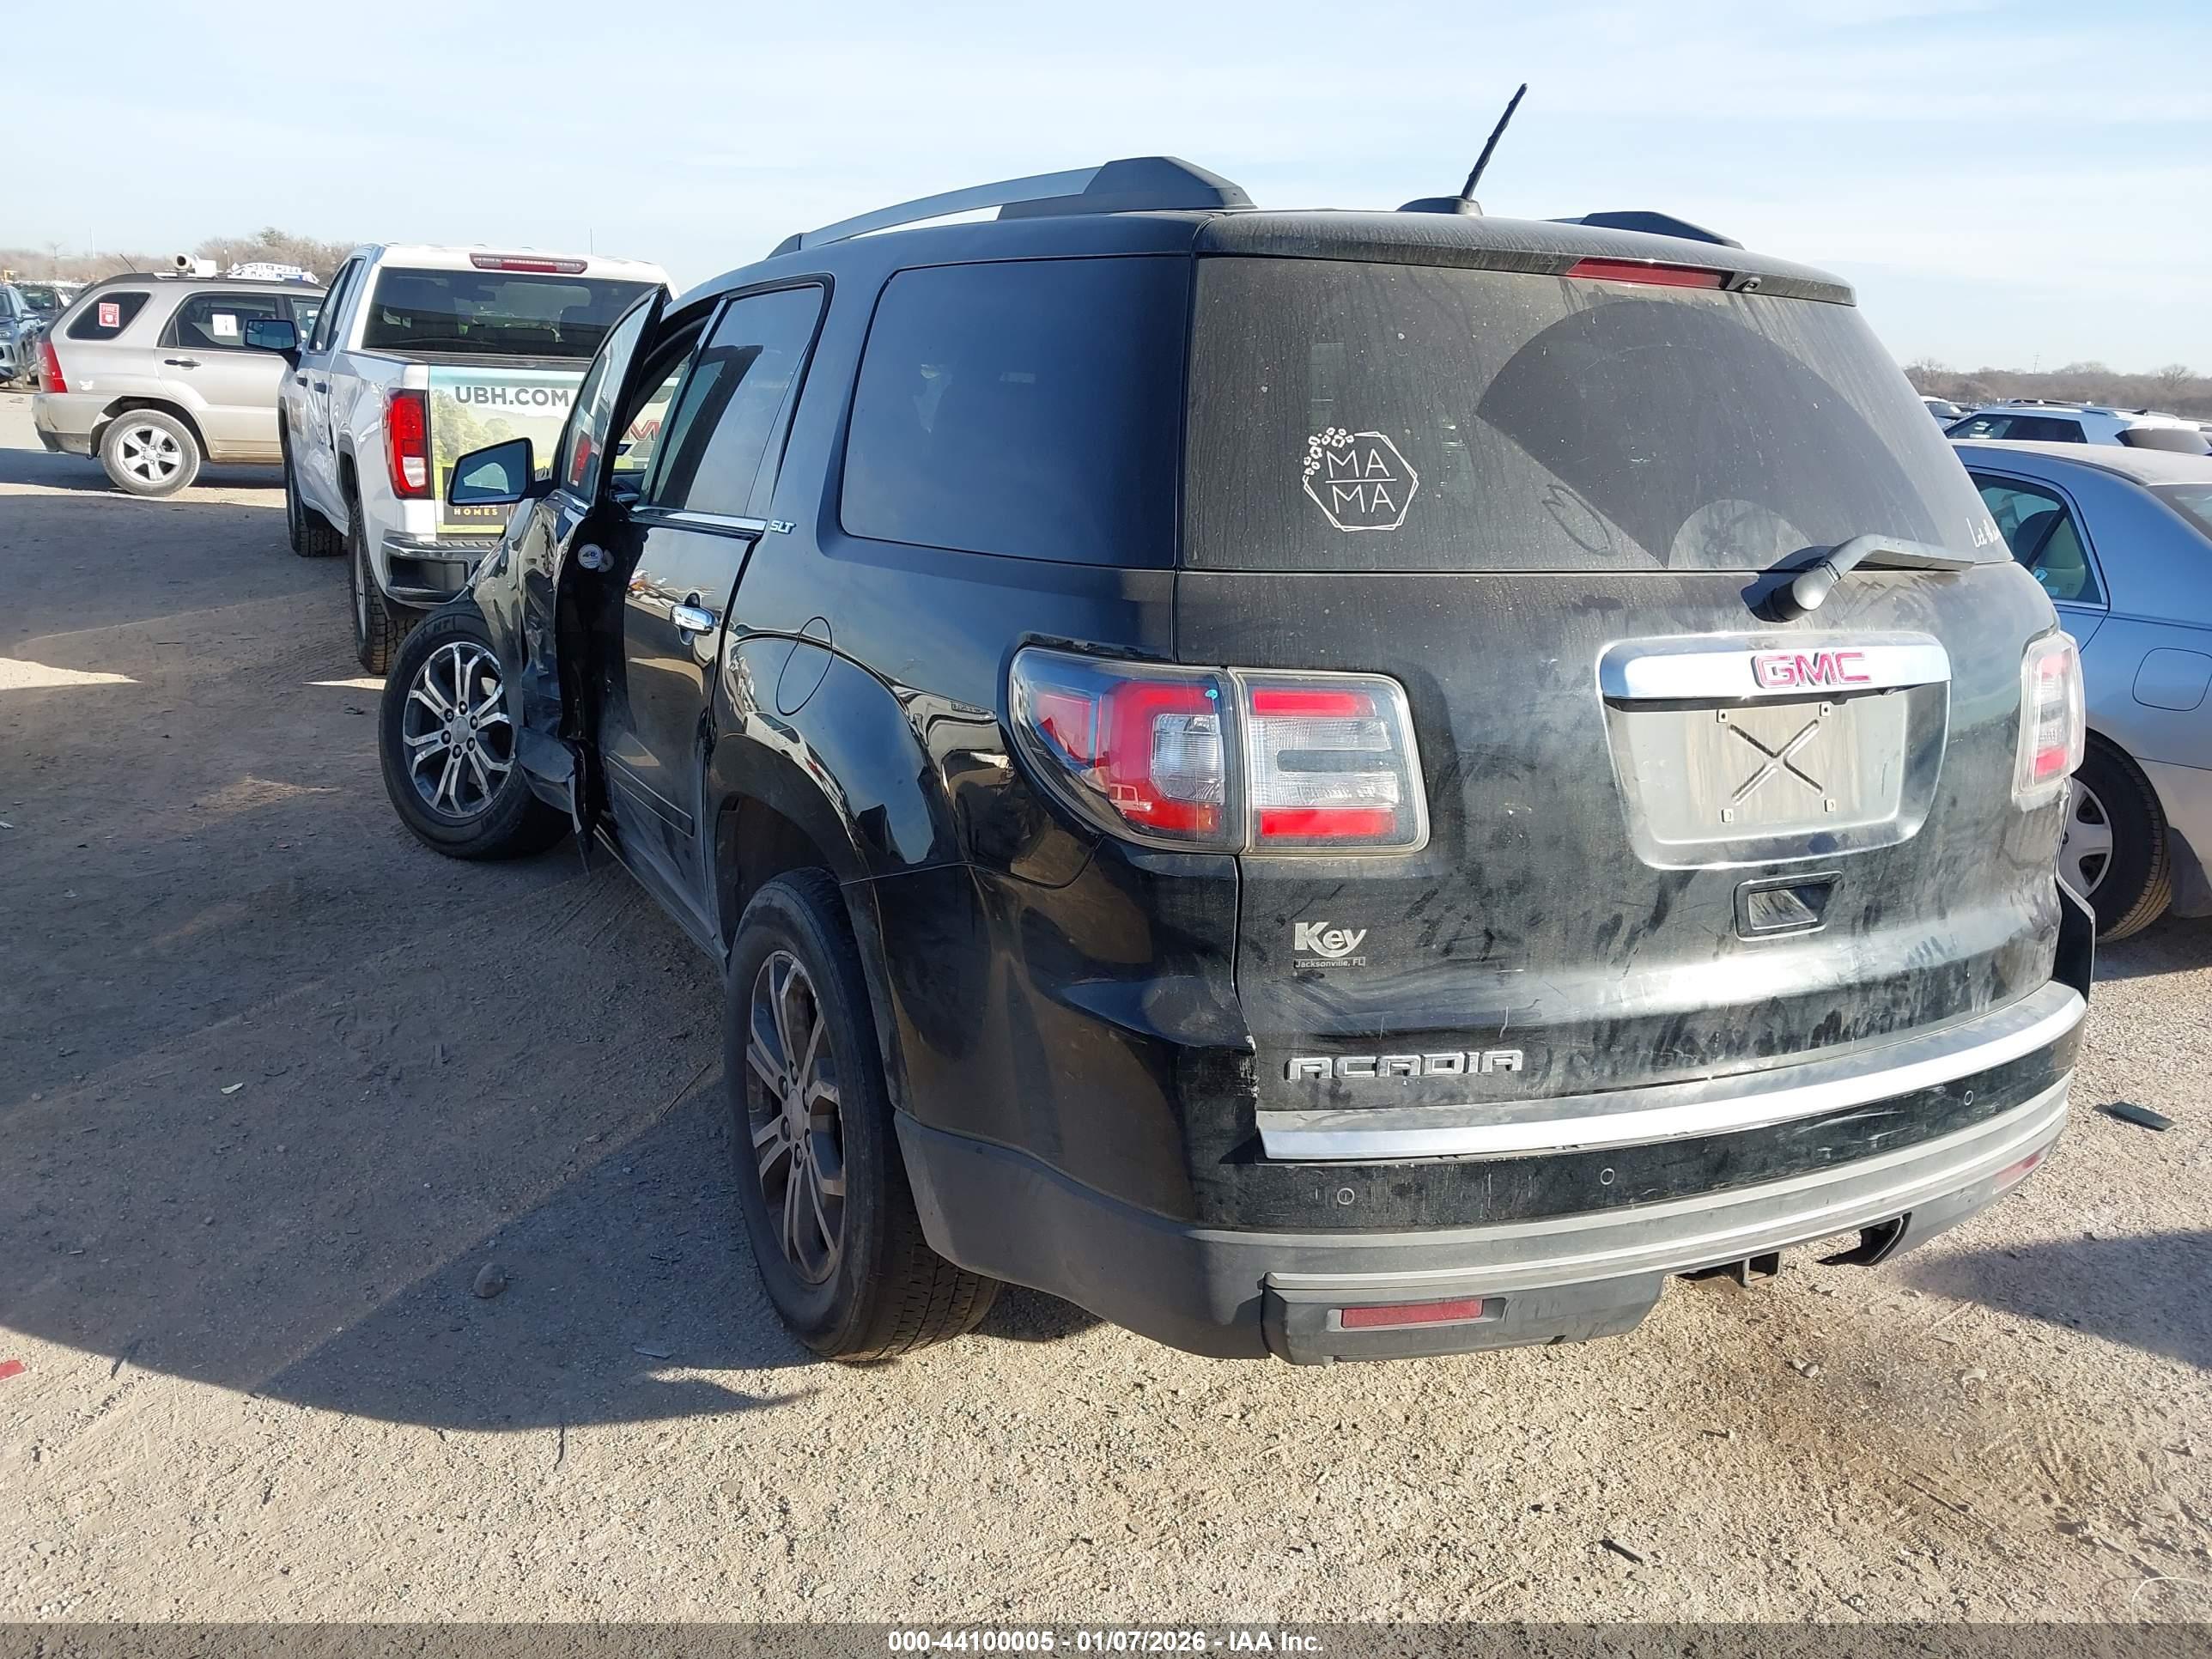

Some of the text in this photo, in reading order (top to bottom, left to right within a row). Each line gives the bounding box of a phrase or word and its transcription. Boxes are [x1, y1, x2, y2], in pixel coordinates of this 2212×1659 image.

[455, 386, 570, 407] UBH.COM
[1326, 447, 1390, 479] MA
[453, 507, 499, 516] HOMES
[1332, 483, 1396, 514] MA
[769, 520, 797, 534] SLT
[1751, 652, 1872, 689] GMC
[1294, 921, 1368, 958] Key
[1295, 957, 1364, 968] Jacksonville, FL
[1284, 1049, 1523, 1080] ACADIA
